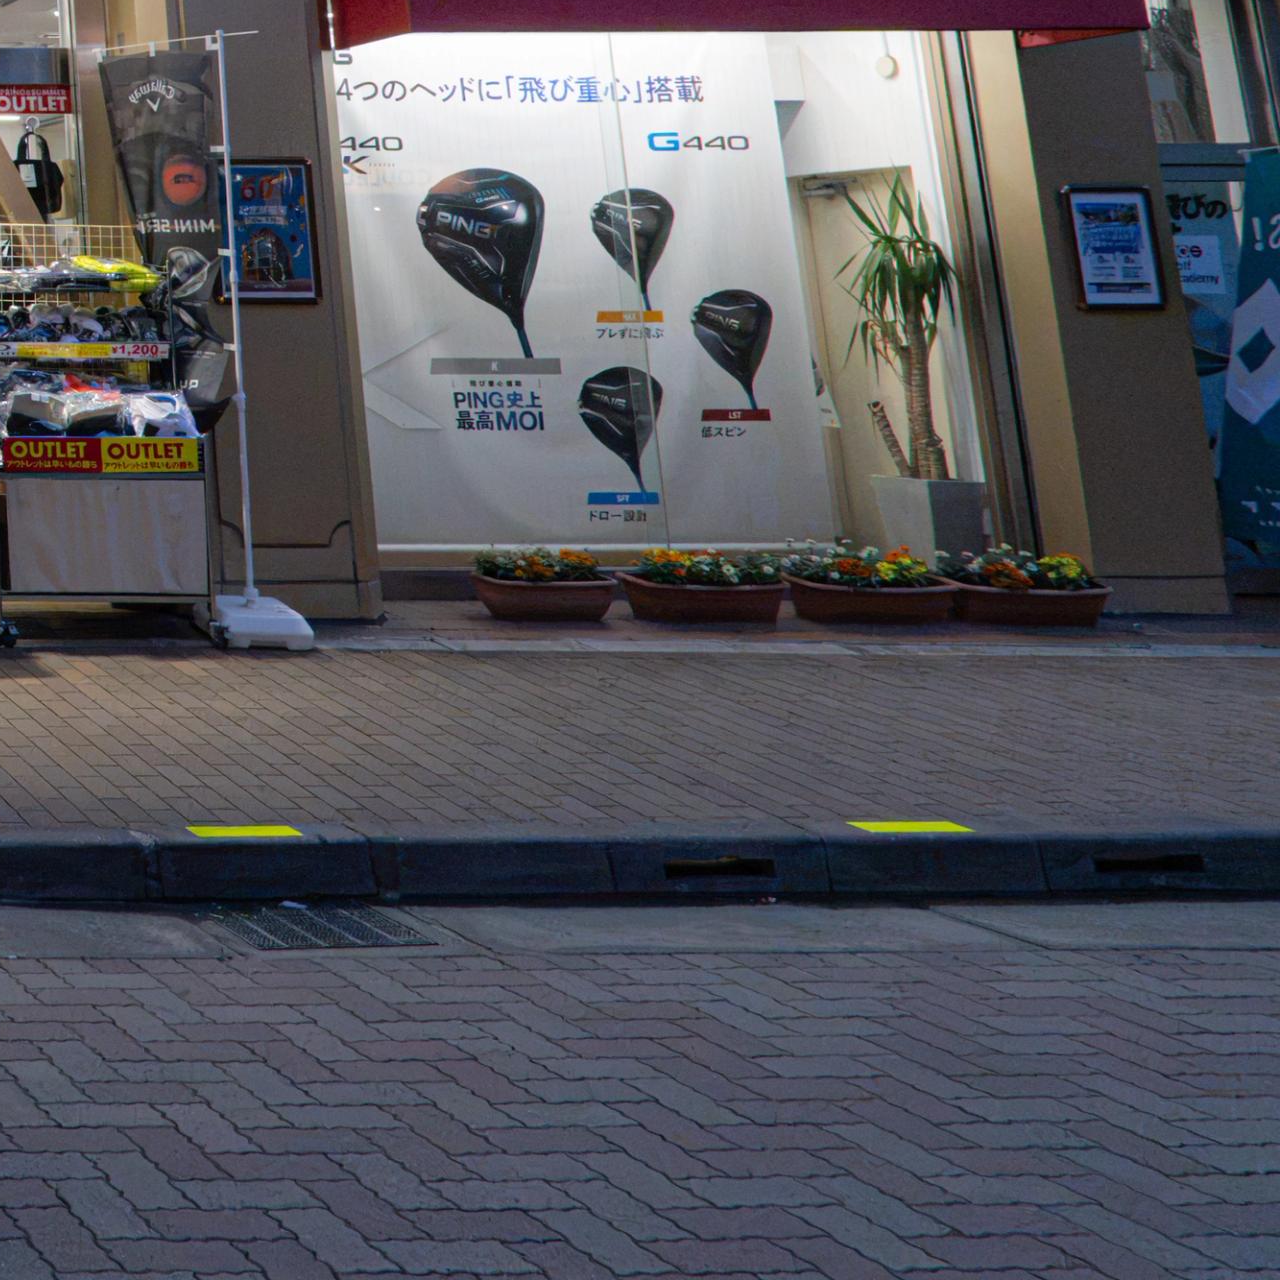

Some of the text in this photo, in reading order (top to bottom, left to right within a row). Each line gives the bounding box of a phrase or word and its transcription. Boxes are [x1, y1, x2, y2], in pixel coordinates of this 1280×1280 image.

[336, 76, 705, 104] 4つのヘッドに「飛び重心」搭載
[647, 132, 750, 152] G440
[436, 211, 492, 239] PING
[112, 344, 159, 356] ¥1,200
[453, 391, 543, 409] PING史上
[455, 410, 545, 431] 最高MOI
[701, 426, 747, 438] 低スピン
[10, 441, 87, 458] OUTLET
[106, 442, 184, 460] OUTLET
